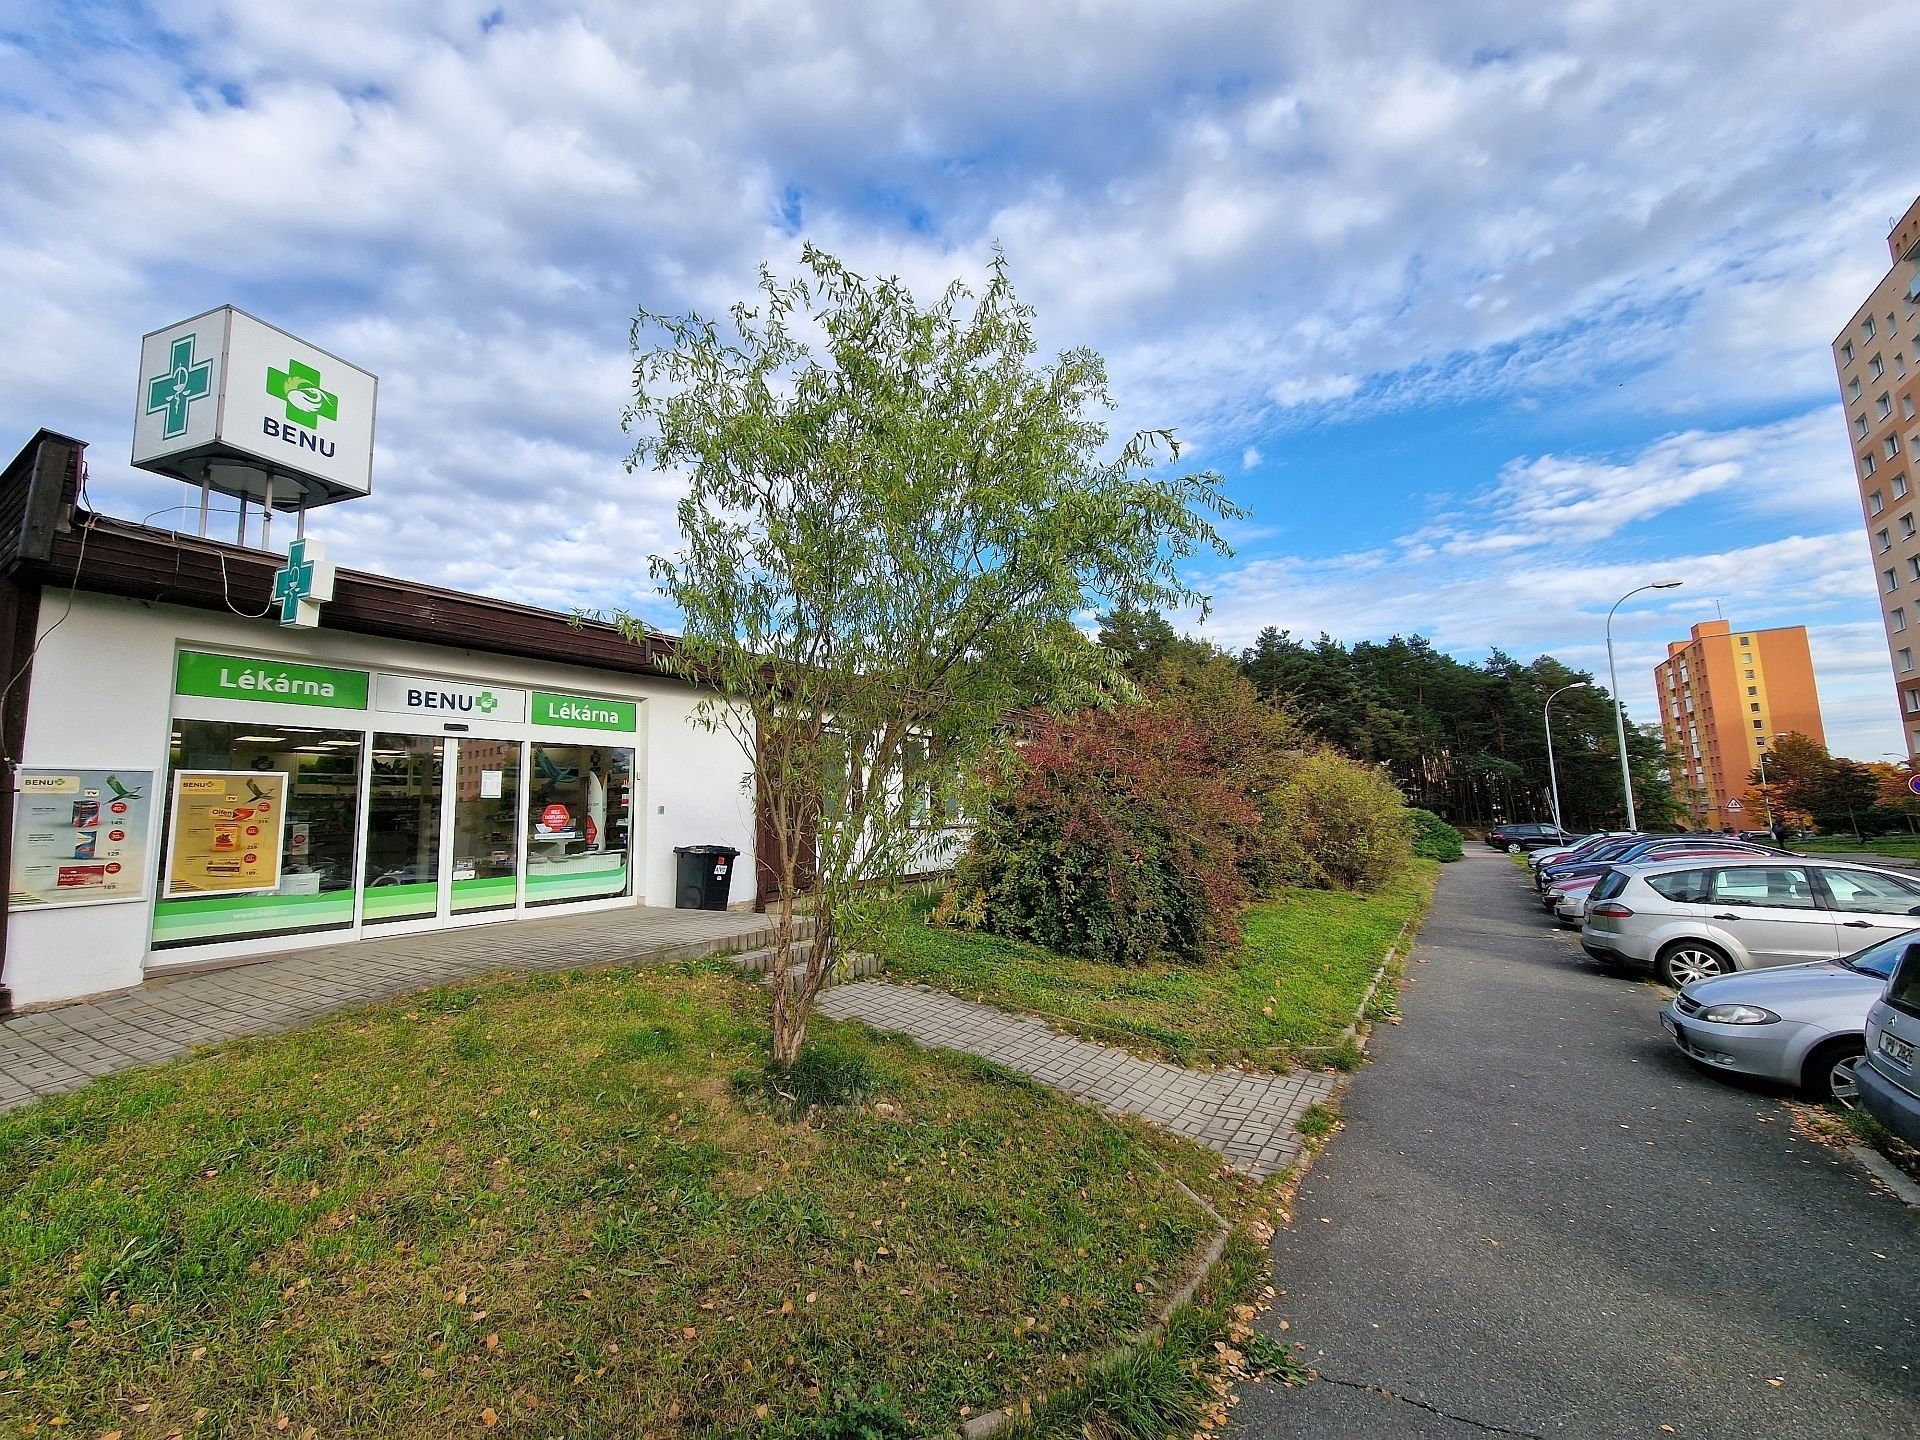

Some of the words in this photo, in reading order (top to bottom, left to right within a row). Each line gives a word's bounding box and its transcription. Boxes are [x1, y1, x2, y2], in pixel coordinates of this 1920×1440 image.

[263, 416, 335, 458] BENU
[219, 668, 335, 697] Lékárna
[406, 689, 474, 711] BENU
[549, 702, 619, 724] Lékárna
